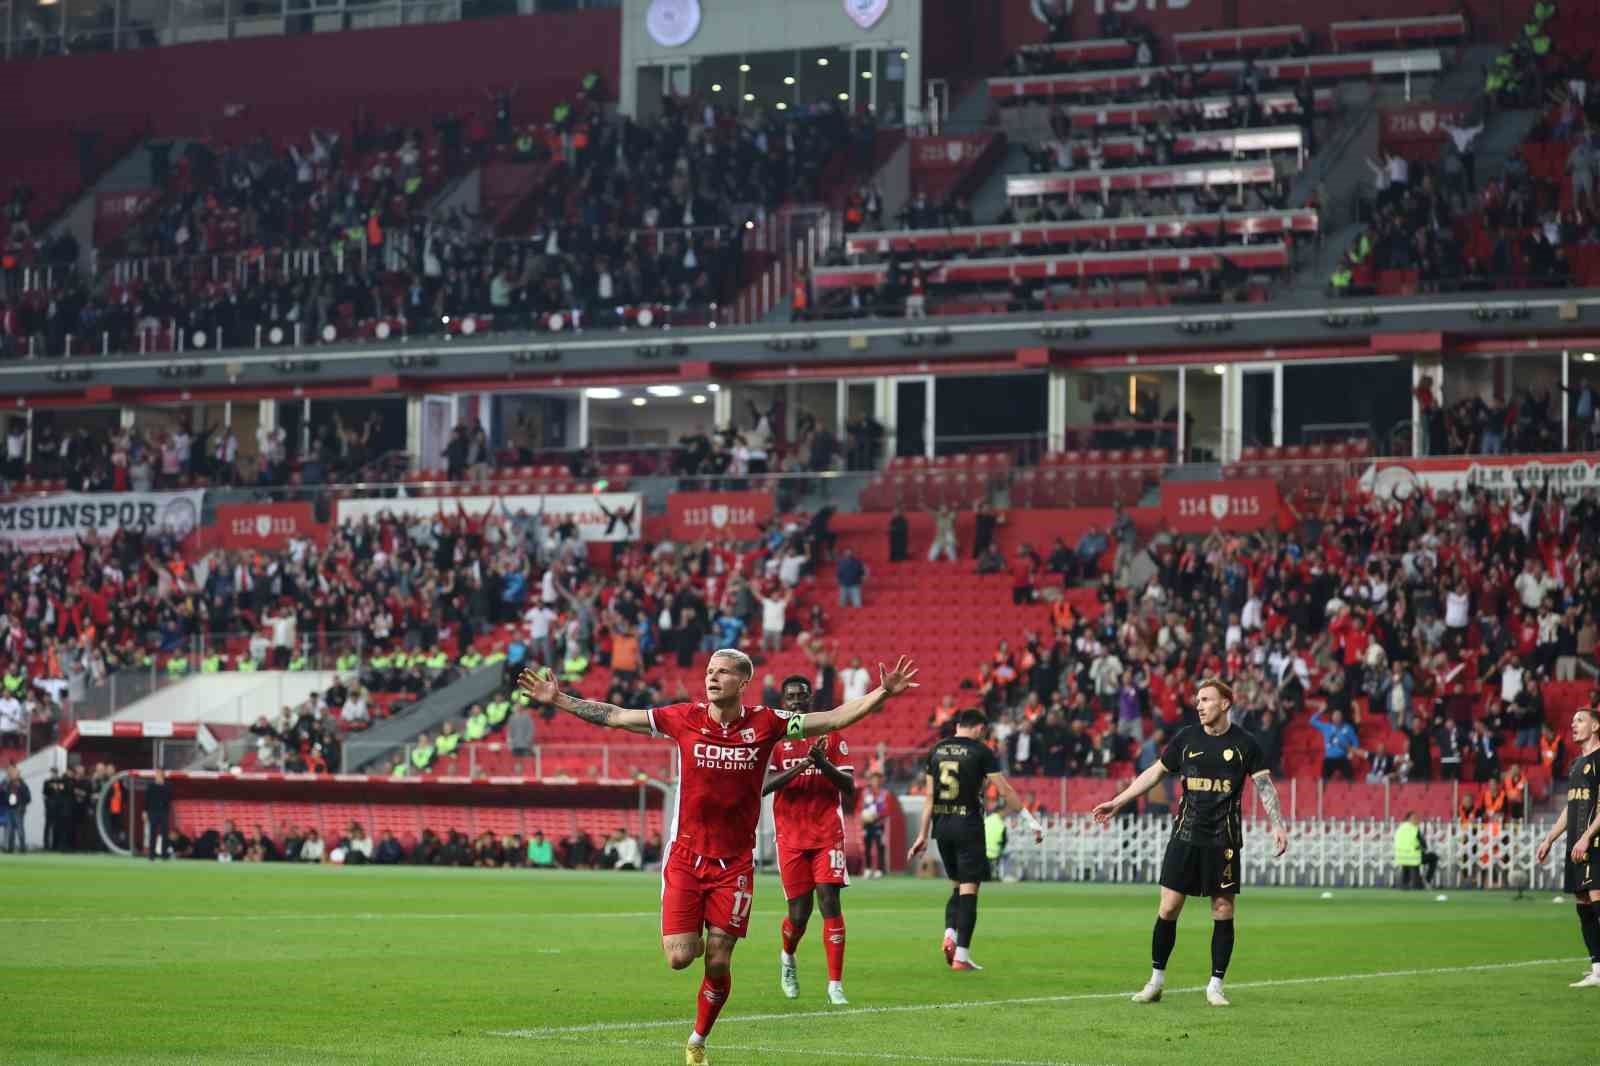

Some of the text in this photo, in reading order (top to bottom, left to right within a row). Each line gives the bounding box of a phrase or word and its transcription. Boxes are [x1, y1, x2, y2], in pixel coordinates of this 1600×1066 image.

[0, 502, 157, 530] MSUNSPOR
[1179, 495, 1260, 516] 114 115
[694, 743, 760, 761] COREX
[696, 759, 755, 770] HOLDING
[938, 760, 960, 800] 5
[828, 848, 845, 870] 18
[1223, 863, 1233, 881] 4
[730, 890, 753, 919] 17
